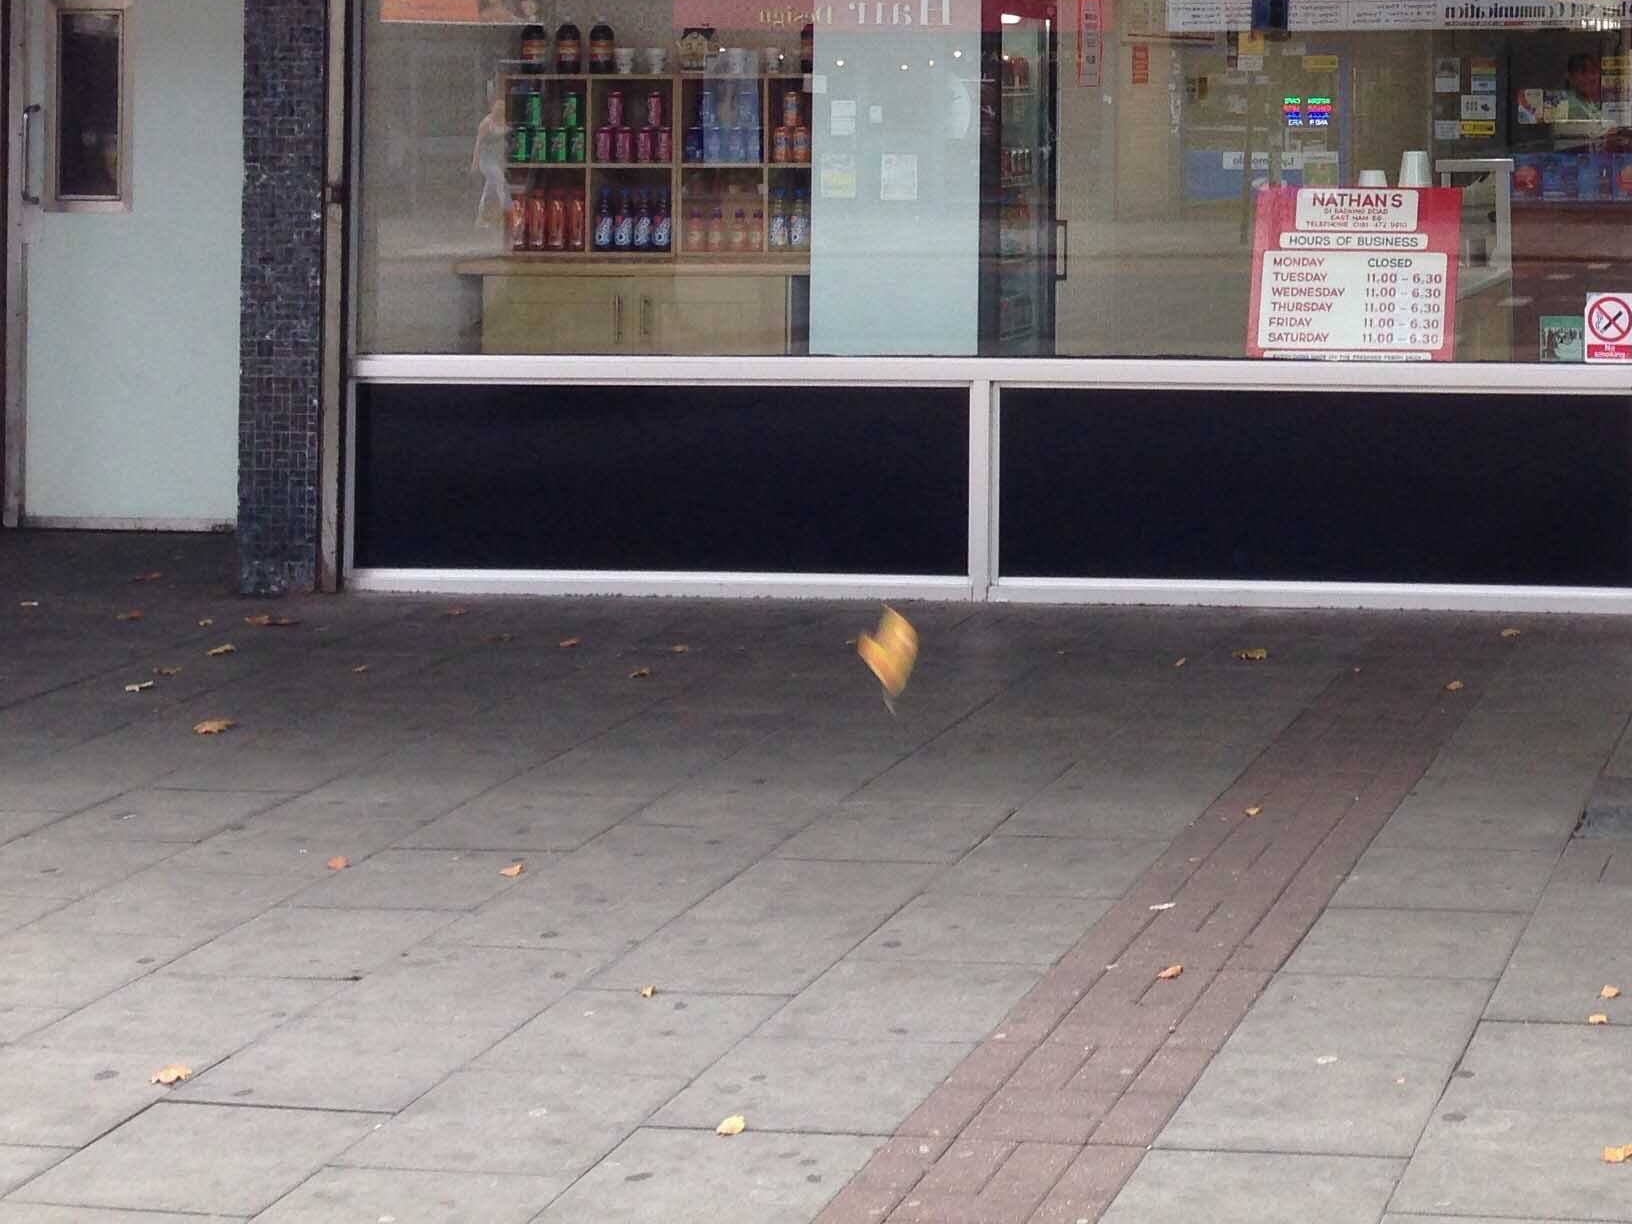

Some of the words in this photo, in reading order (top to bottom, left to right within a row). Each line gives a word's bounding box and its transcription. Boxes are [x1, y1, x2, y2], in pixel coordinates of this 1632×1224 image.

[1312, 192, 1403, 208] NATHAN'S
[1289, 235, 1331, 246] HOURS
[1336, 235, 1353, 247] OF
[1357, 236, 1419, 248] BUSINESS
[1272, 257, 1325, 268] MONDAY
[1367, 258, 1413, 269] CLOSED
[1272, 271, 1328, 282] TUESDAY
[1271, 287, 1345, 298] WEDNESDAY
[1271, 302, 1333, 313] THURSDAY
[1268, 317, 1312, 328] FRIDAY
[1267, 332, 1330, 343] SATURDAY
